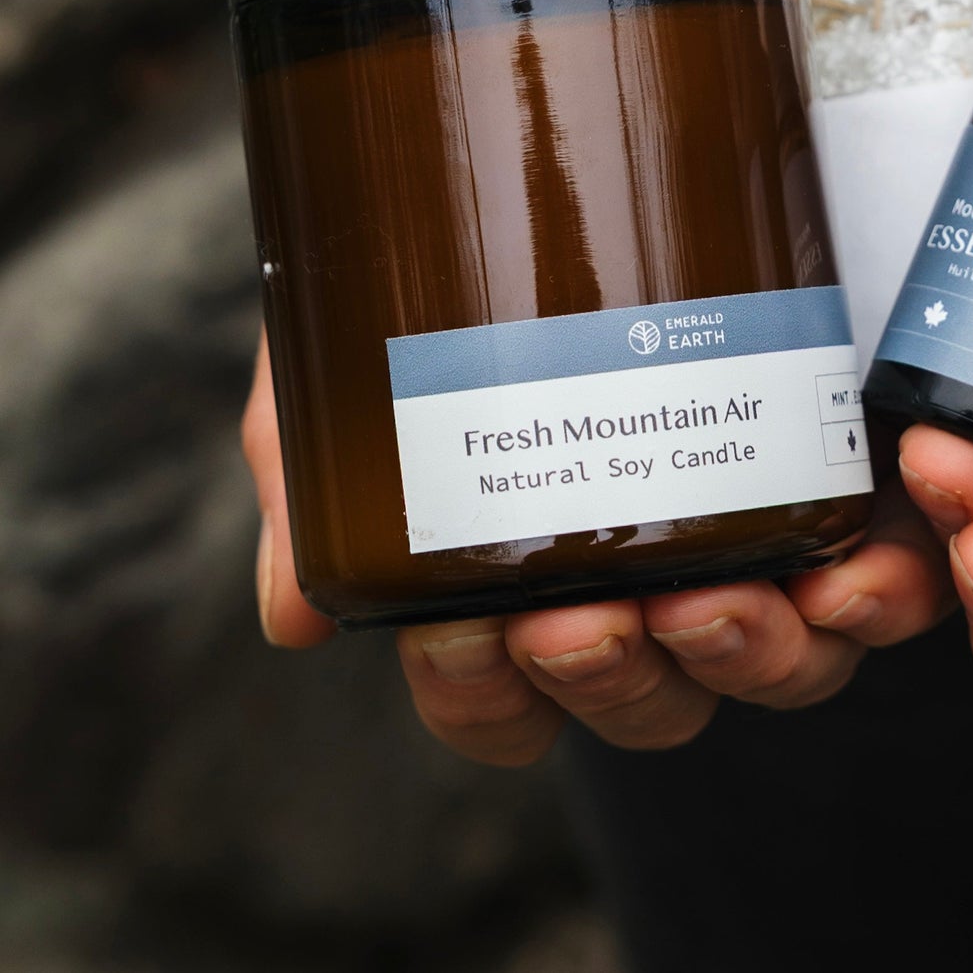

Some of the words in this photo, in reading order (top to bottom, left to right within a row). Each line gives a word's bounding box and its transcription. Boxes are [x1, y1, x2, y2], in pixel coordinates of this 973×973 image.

[665, 313, 723, 330] EMERALD
[669, 329, 725, 350] EARTH
[831, 390, 849, 407] MINT
[464, 419, 553, 456] Fresh
[563, 399, 717, 443] Mountain
[724, 393, 763, 423] Air
[479, 461, 591, 495] Natural
[608, 457, 654, 479] Soy
[671, 441, 756, 470] Candle
